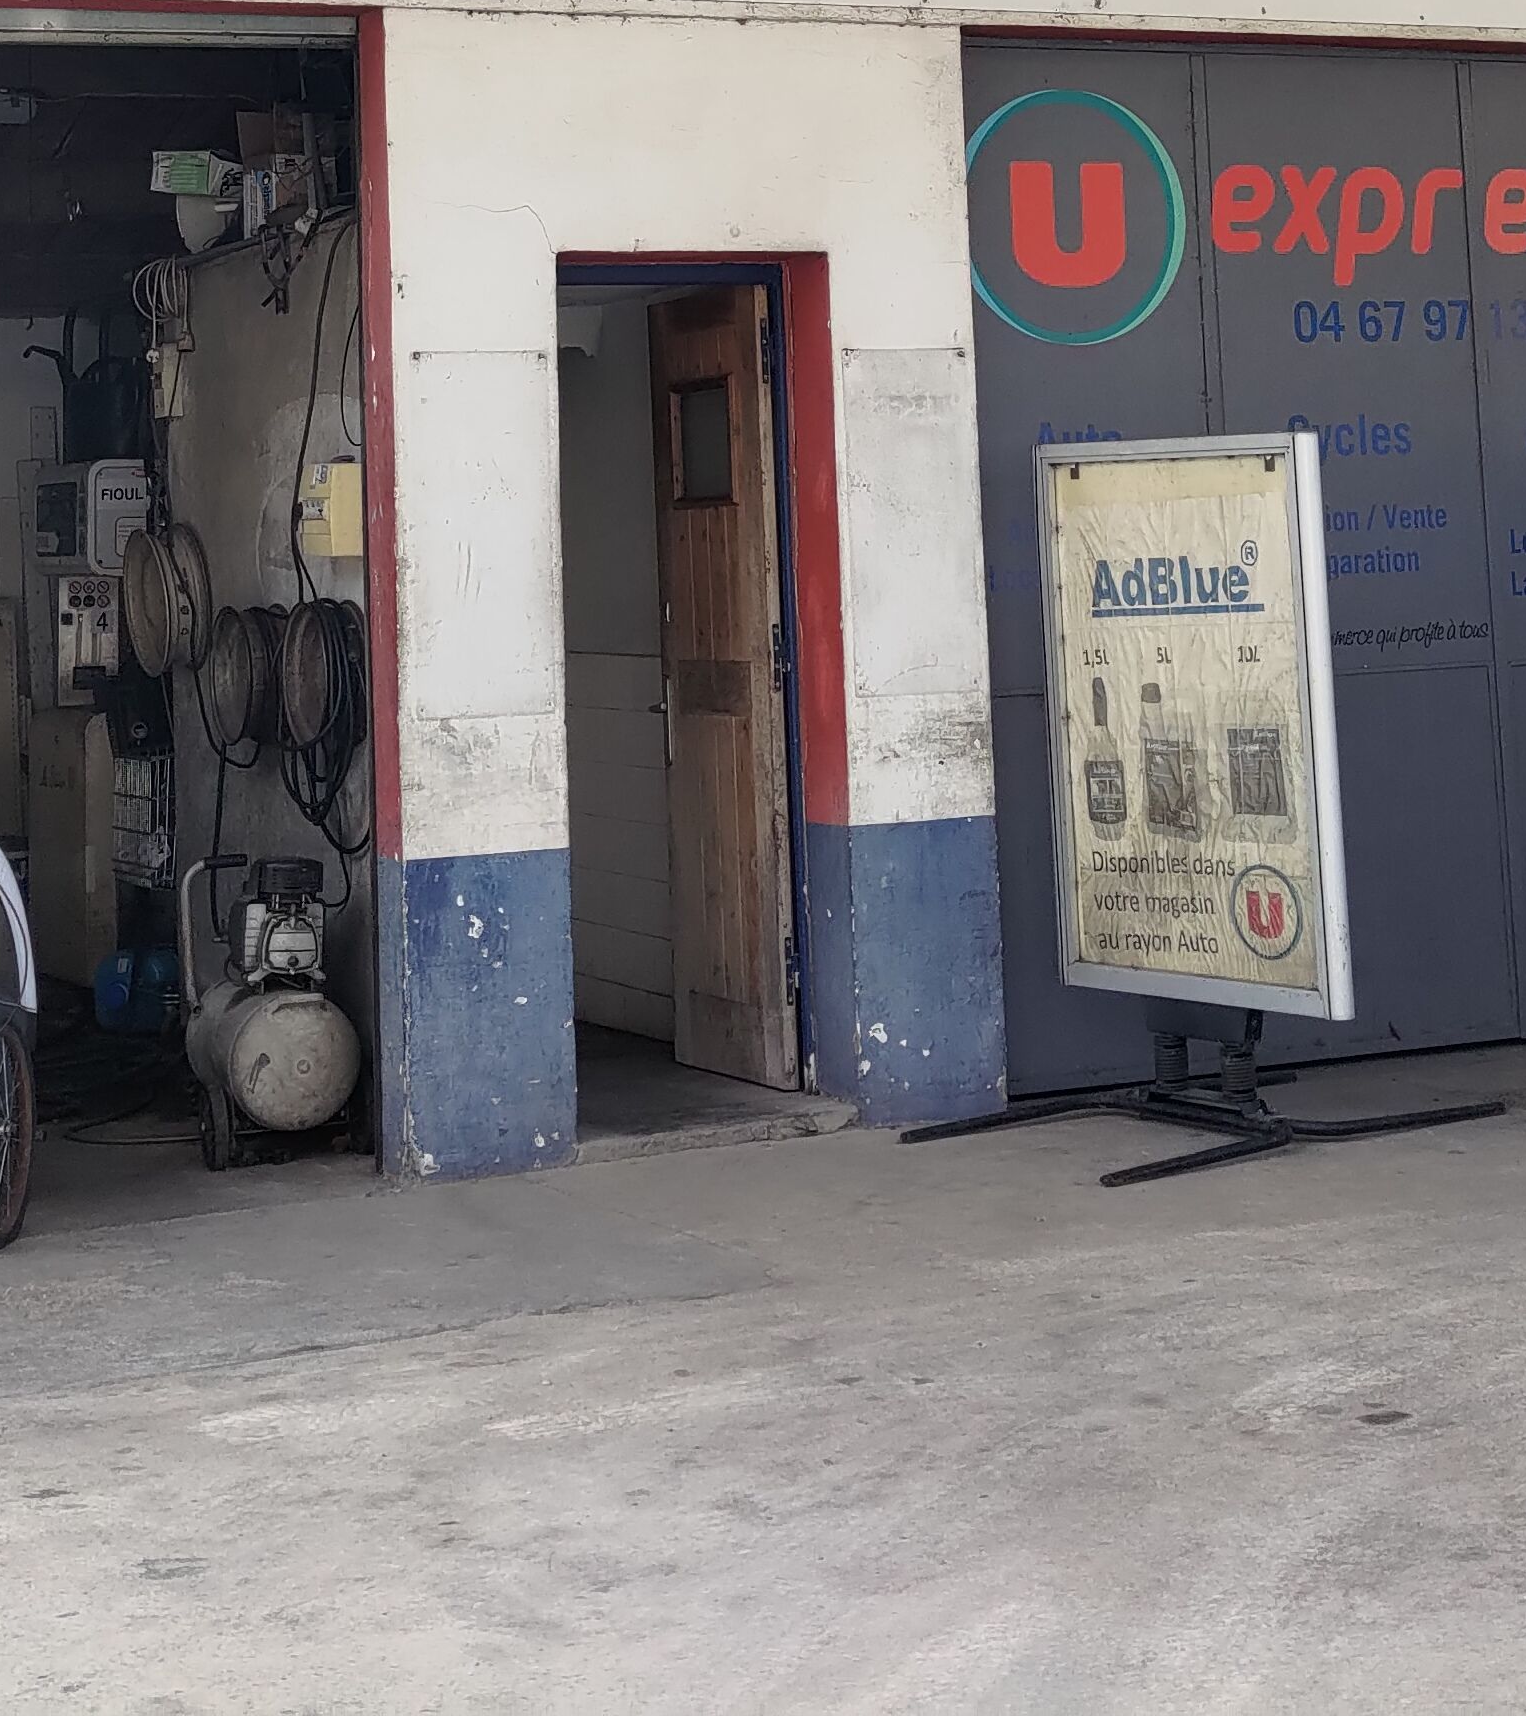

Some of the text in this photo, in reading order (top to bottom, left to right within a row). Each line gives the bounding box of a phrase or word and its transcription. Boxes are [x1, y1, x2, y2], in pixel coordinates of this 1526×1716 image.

[1009, 161, 1127, 289] U
[1293, 300, 1346, 344] 04
[1358, 300, 1406, 343] 67
[1423, 299, 1469, 342] 97
[101, 488, 144, 501] FIOUL
[1383, 504, 1447, 529] Vente
[96, 611, 109, 632] 4
[1376, 628, 1397, 652] qui
[1399, 622, 1445, 650] profite
[1446, 617, 1457, 642] à
[1459, 620, 1489, 641] tous
[1156, 647, 1172, 664] 5L
[1092, 850, 1235, 877] Disponibles dans
[1095, 892, 1215, 918] votre magasin
[1246, 890, 1284, 939] U
[1098, 930, 1218, 956] au rayon Auto
